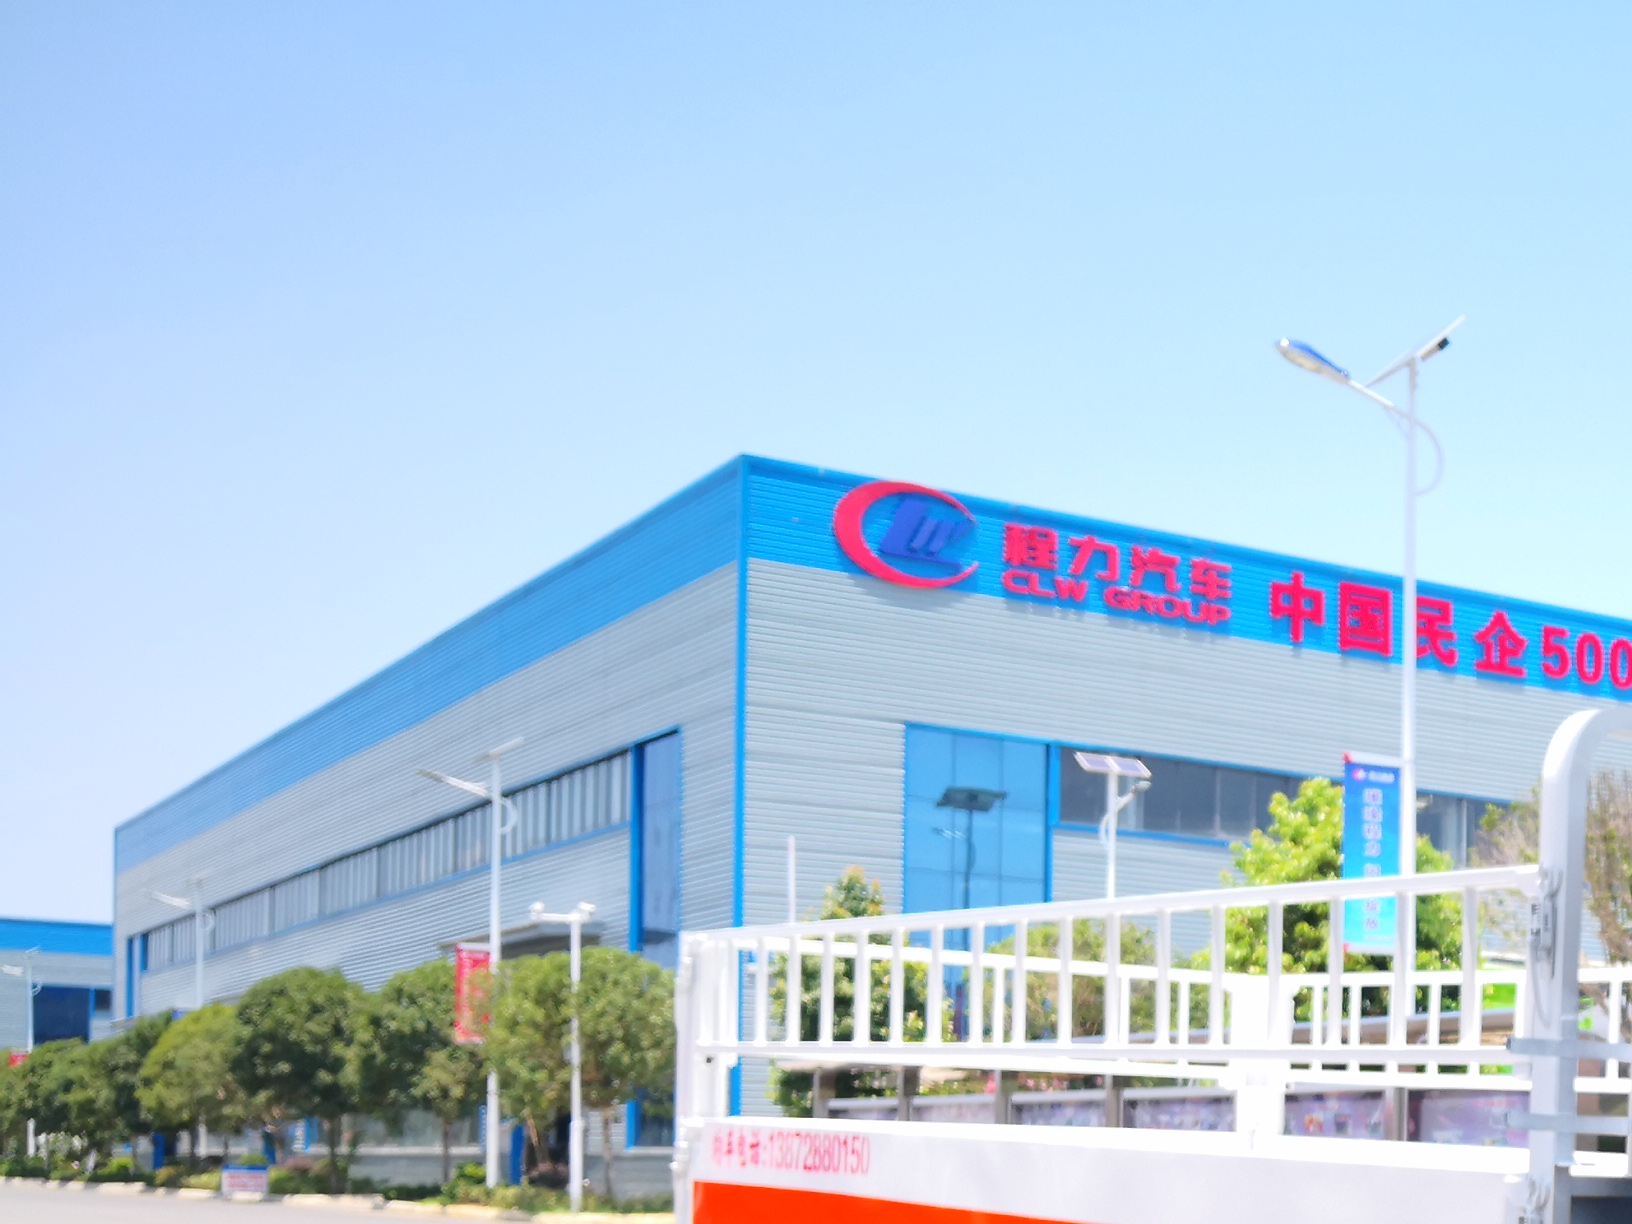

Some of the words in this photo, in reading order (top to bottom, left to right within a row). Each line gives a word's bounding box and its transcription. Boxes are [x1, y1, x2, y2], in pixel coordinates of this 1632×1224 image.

[1003, 522, 1233, 600] 程力汽车
[1002, 569, 1088, 602] CLW
[1103, 585, 1232, 625] GROUP
